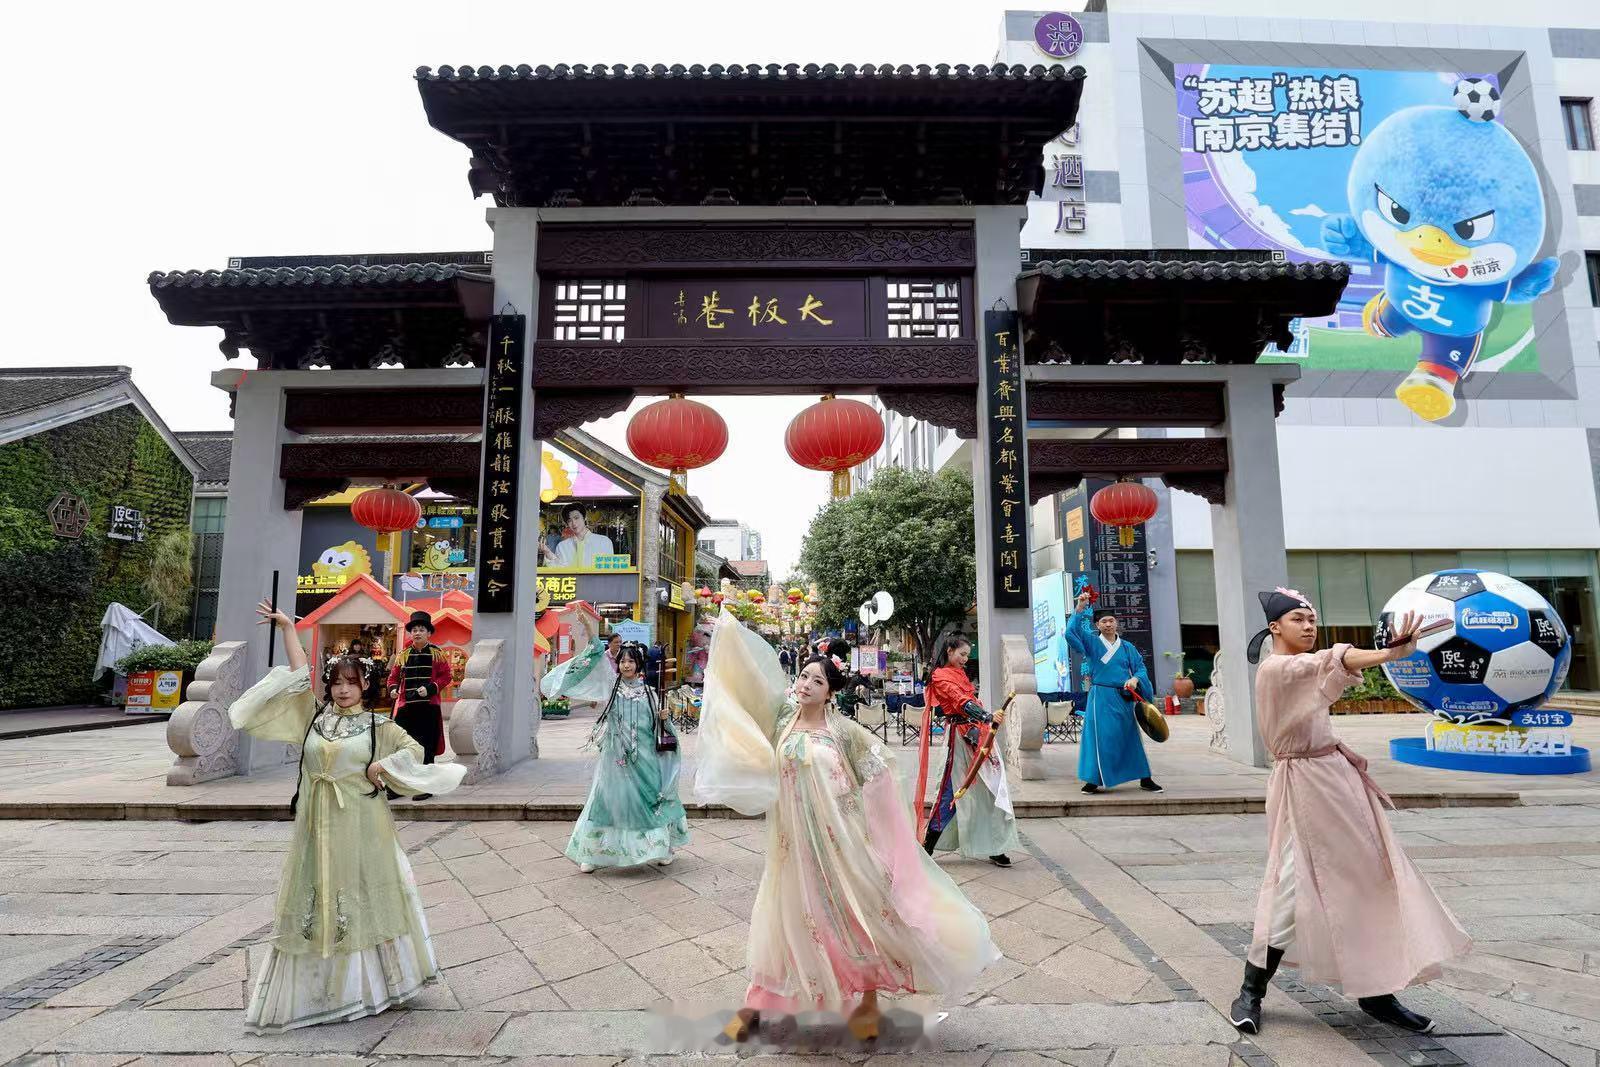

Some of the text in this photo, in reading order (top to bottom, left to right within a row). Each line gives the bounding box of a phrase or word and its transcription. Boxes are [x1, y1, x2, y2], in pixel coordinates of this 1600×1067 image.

[1184, 73, 1364, 116] “苏超”热浪
[1471, 260, 1501, 277] 南京
[695, 290, 833, 328] 大板巷
[1440, 650, 1465, 669] 熙
[1521, 713, 1565, 725] 支付宝
